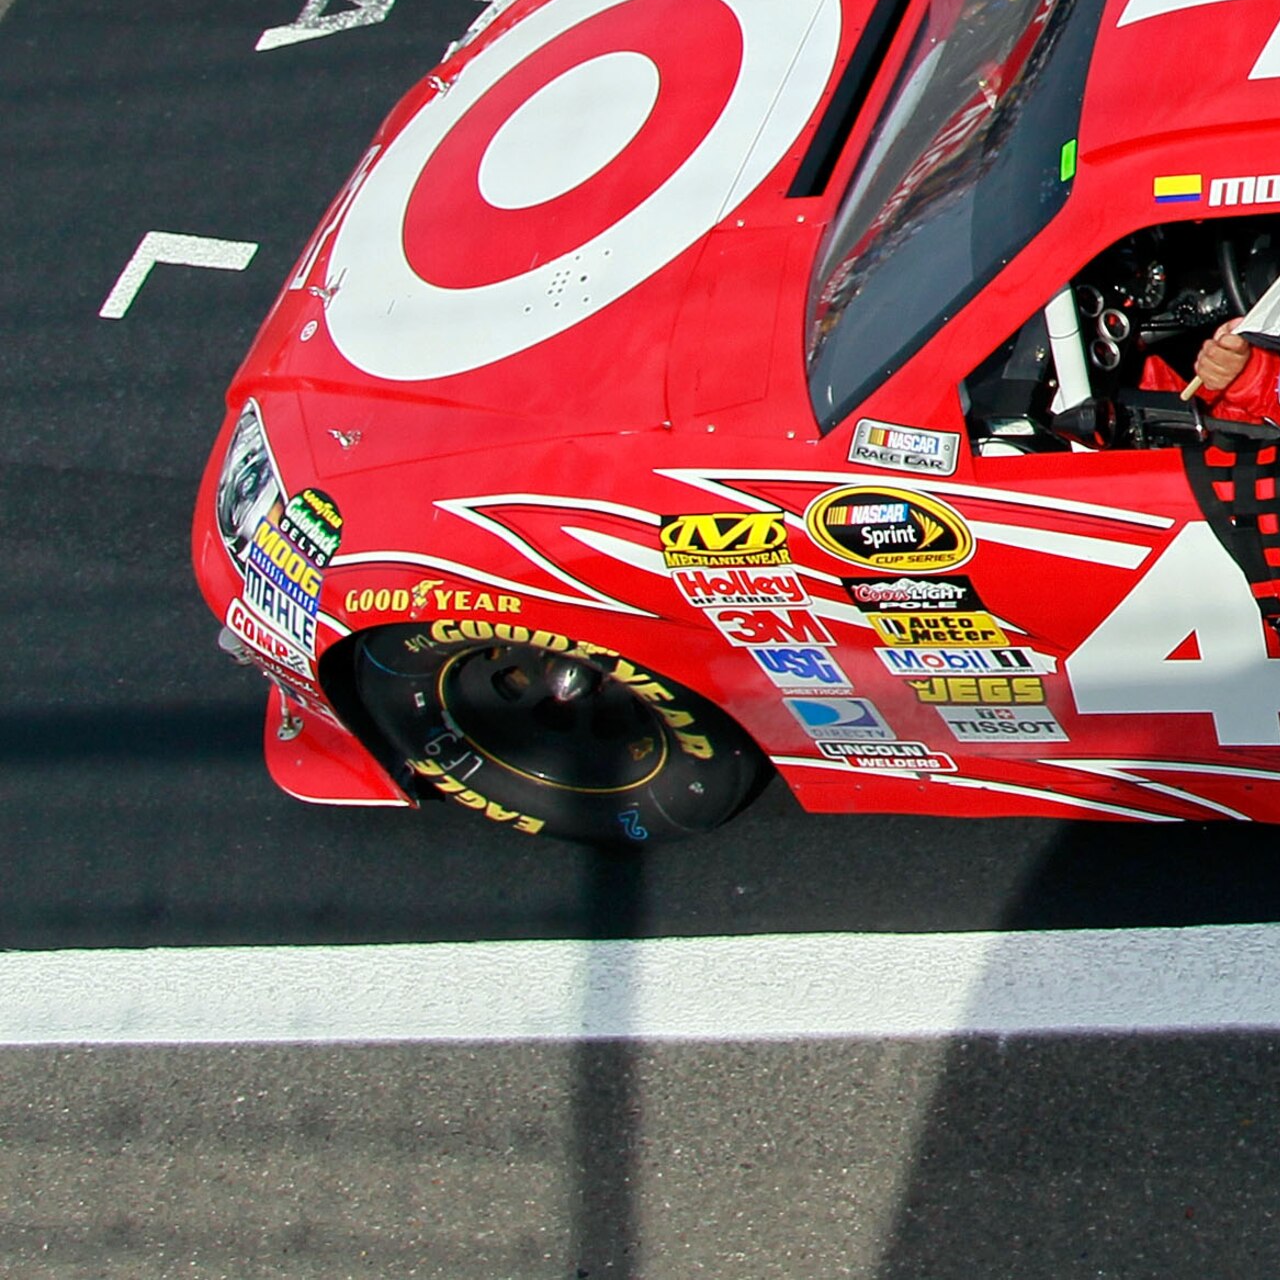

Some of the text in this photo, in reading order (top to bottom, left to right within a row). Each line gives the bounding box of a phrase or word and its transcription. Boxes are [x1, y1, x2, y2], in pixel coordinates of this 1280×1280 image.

[887, 429, 938, 455] NASCAR
[904, 455, 945, 469] CAR
[850, 503, 907, 525] NASCAR
[284, 495, 340, 556] Gatorback
[861, 524, 917, 549] Sprint
[279, 519, 326, 567] BELTS
[253, 521, 323, 599] MOOG
[665, 549, 792, 568] MECHANIX WEAR
[875, 553, 956, 564] CUP SERIES
[676, 569, 805, 603] Holley
[851, 583, 966, 602] Coors LIGHT
[247, 568, 317, 655] MAHLE
[879, 601, 958, 609] POLE
[231, 606, 289, 659] COMP
[717, 609, 832, 644] 3M
[909, 616, 974, 630] Auto
[910, 627, 997, 643] Meter
[752, 647, 845, 684] USG
[884, 649, 991, 670] Mobil
[918, 676, 1045, 703] JEGS
[811, 727, 887, 739] DIRECTV
[948, 721, 1056, 734] TISSOT
[825, 743, 923, 757] LINCOLN
[857, 757, 941, 769] WELDERS
[406, 757, 546, 836] EAGLE
